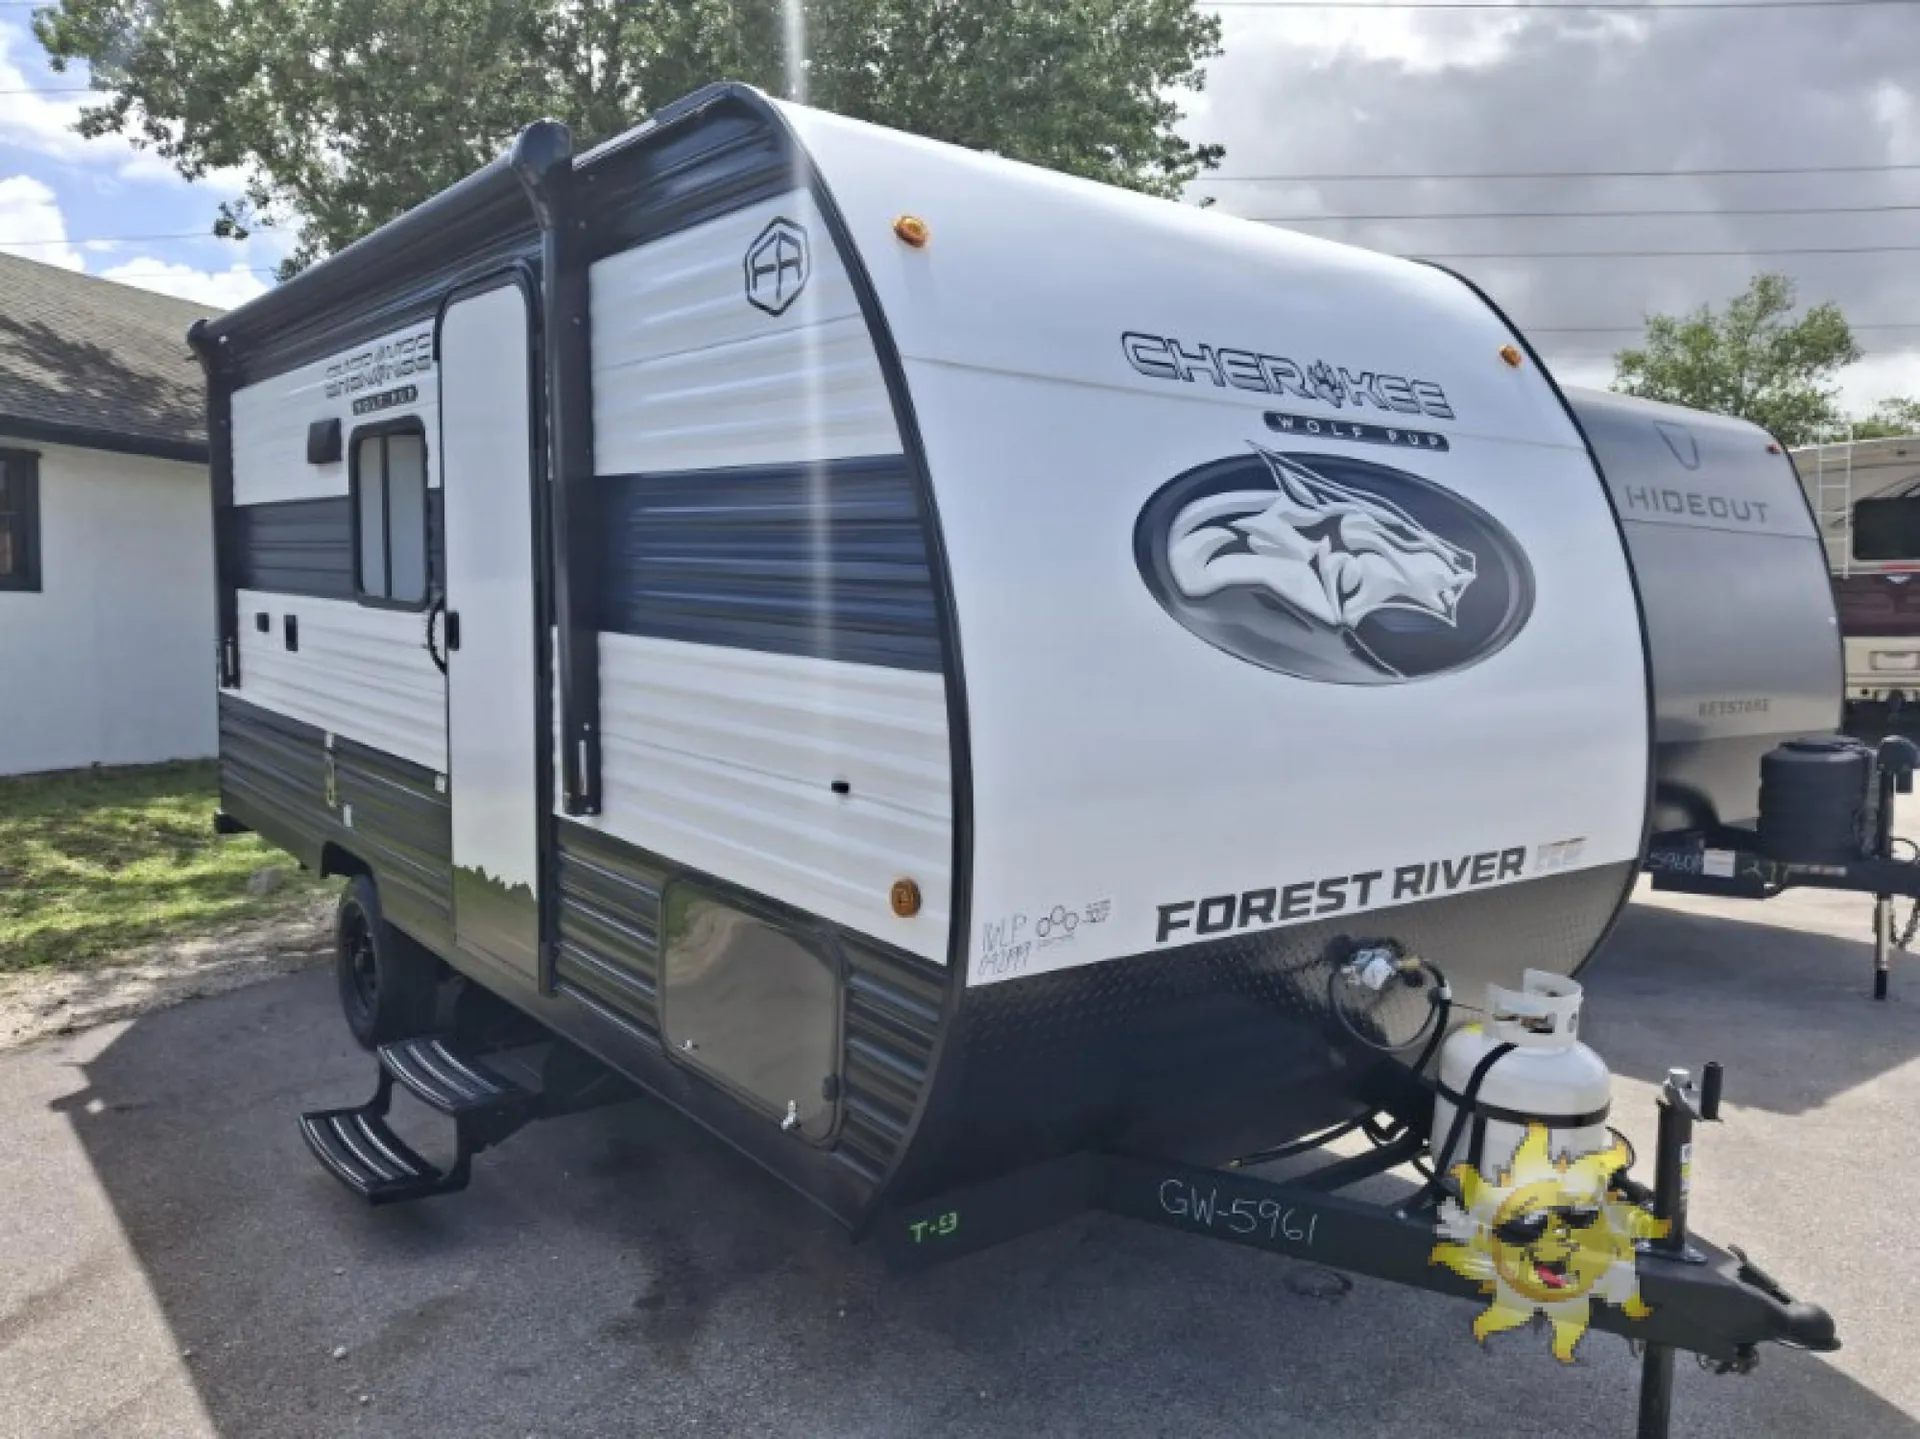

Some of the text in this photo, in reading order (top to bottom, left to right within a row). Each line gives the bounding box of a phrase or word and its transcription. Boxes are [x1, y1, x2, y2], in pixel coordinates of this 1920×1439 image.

[1120, 331, 1456, 420] CHEROKEE
[1276, 414, 1439, 446] WOLF PUP
[1624, 485, 1769, 523] HIDEOUT
[1155, 870, 1384, 943] FOREST
[1392, 845, 1527, 900] RIVER
[1159, 1178, 1319, 1246] GW-5961
